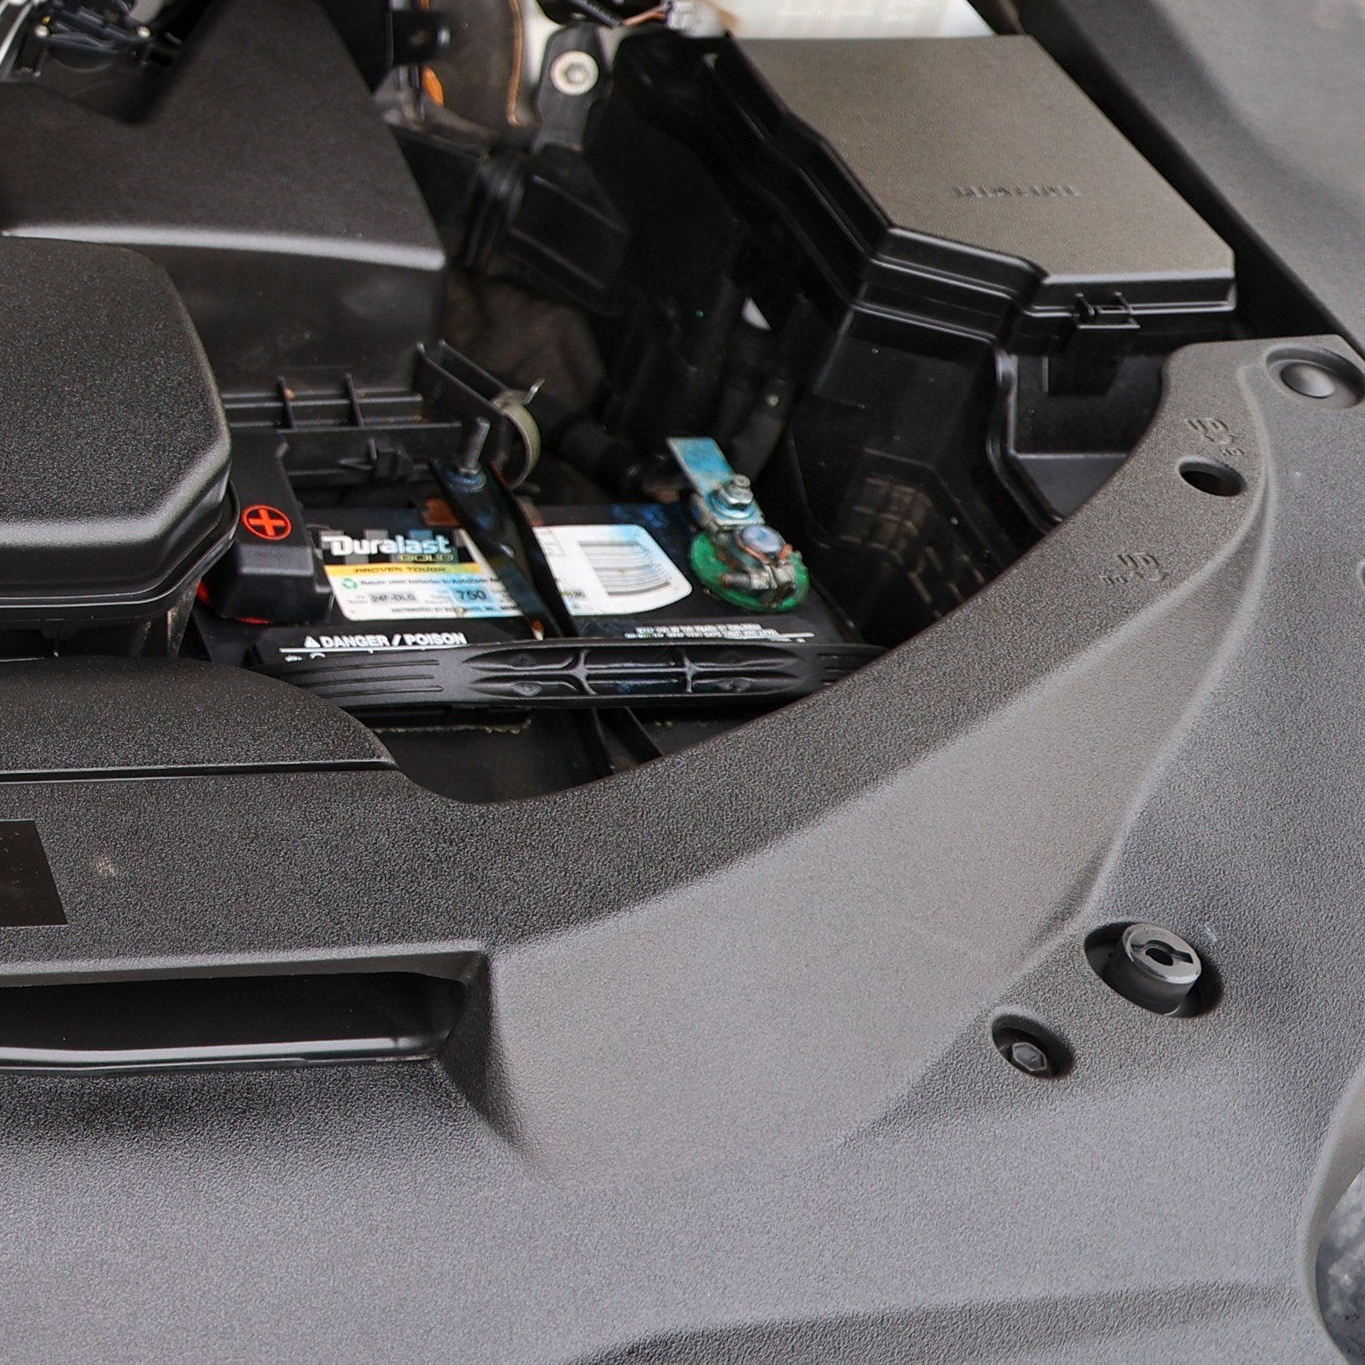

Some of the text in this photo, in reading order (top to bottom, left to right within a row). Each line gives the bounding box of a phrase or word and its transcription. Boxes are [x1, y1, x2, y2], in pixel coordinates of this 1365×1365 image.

[321, 535, 453, 556] Duralast
[456, 590, 488, 601] 750
[320, 632, 468, 648] DANGER / POISON
